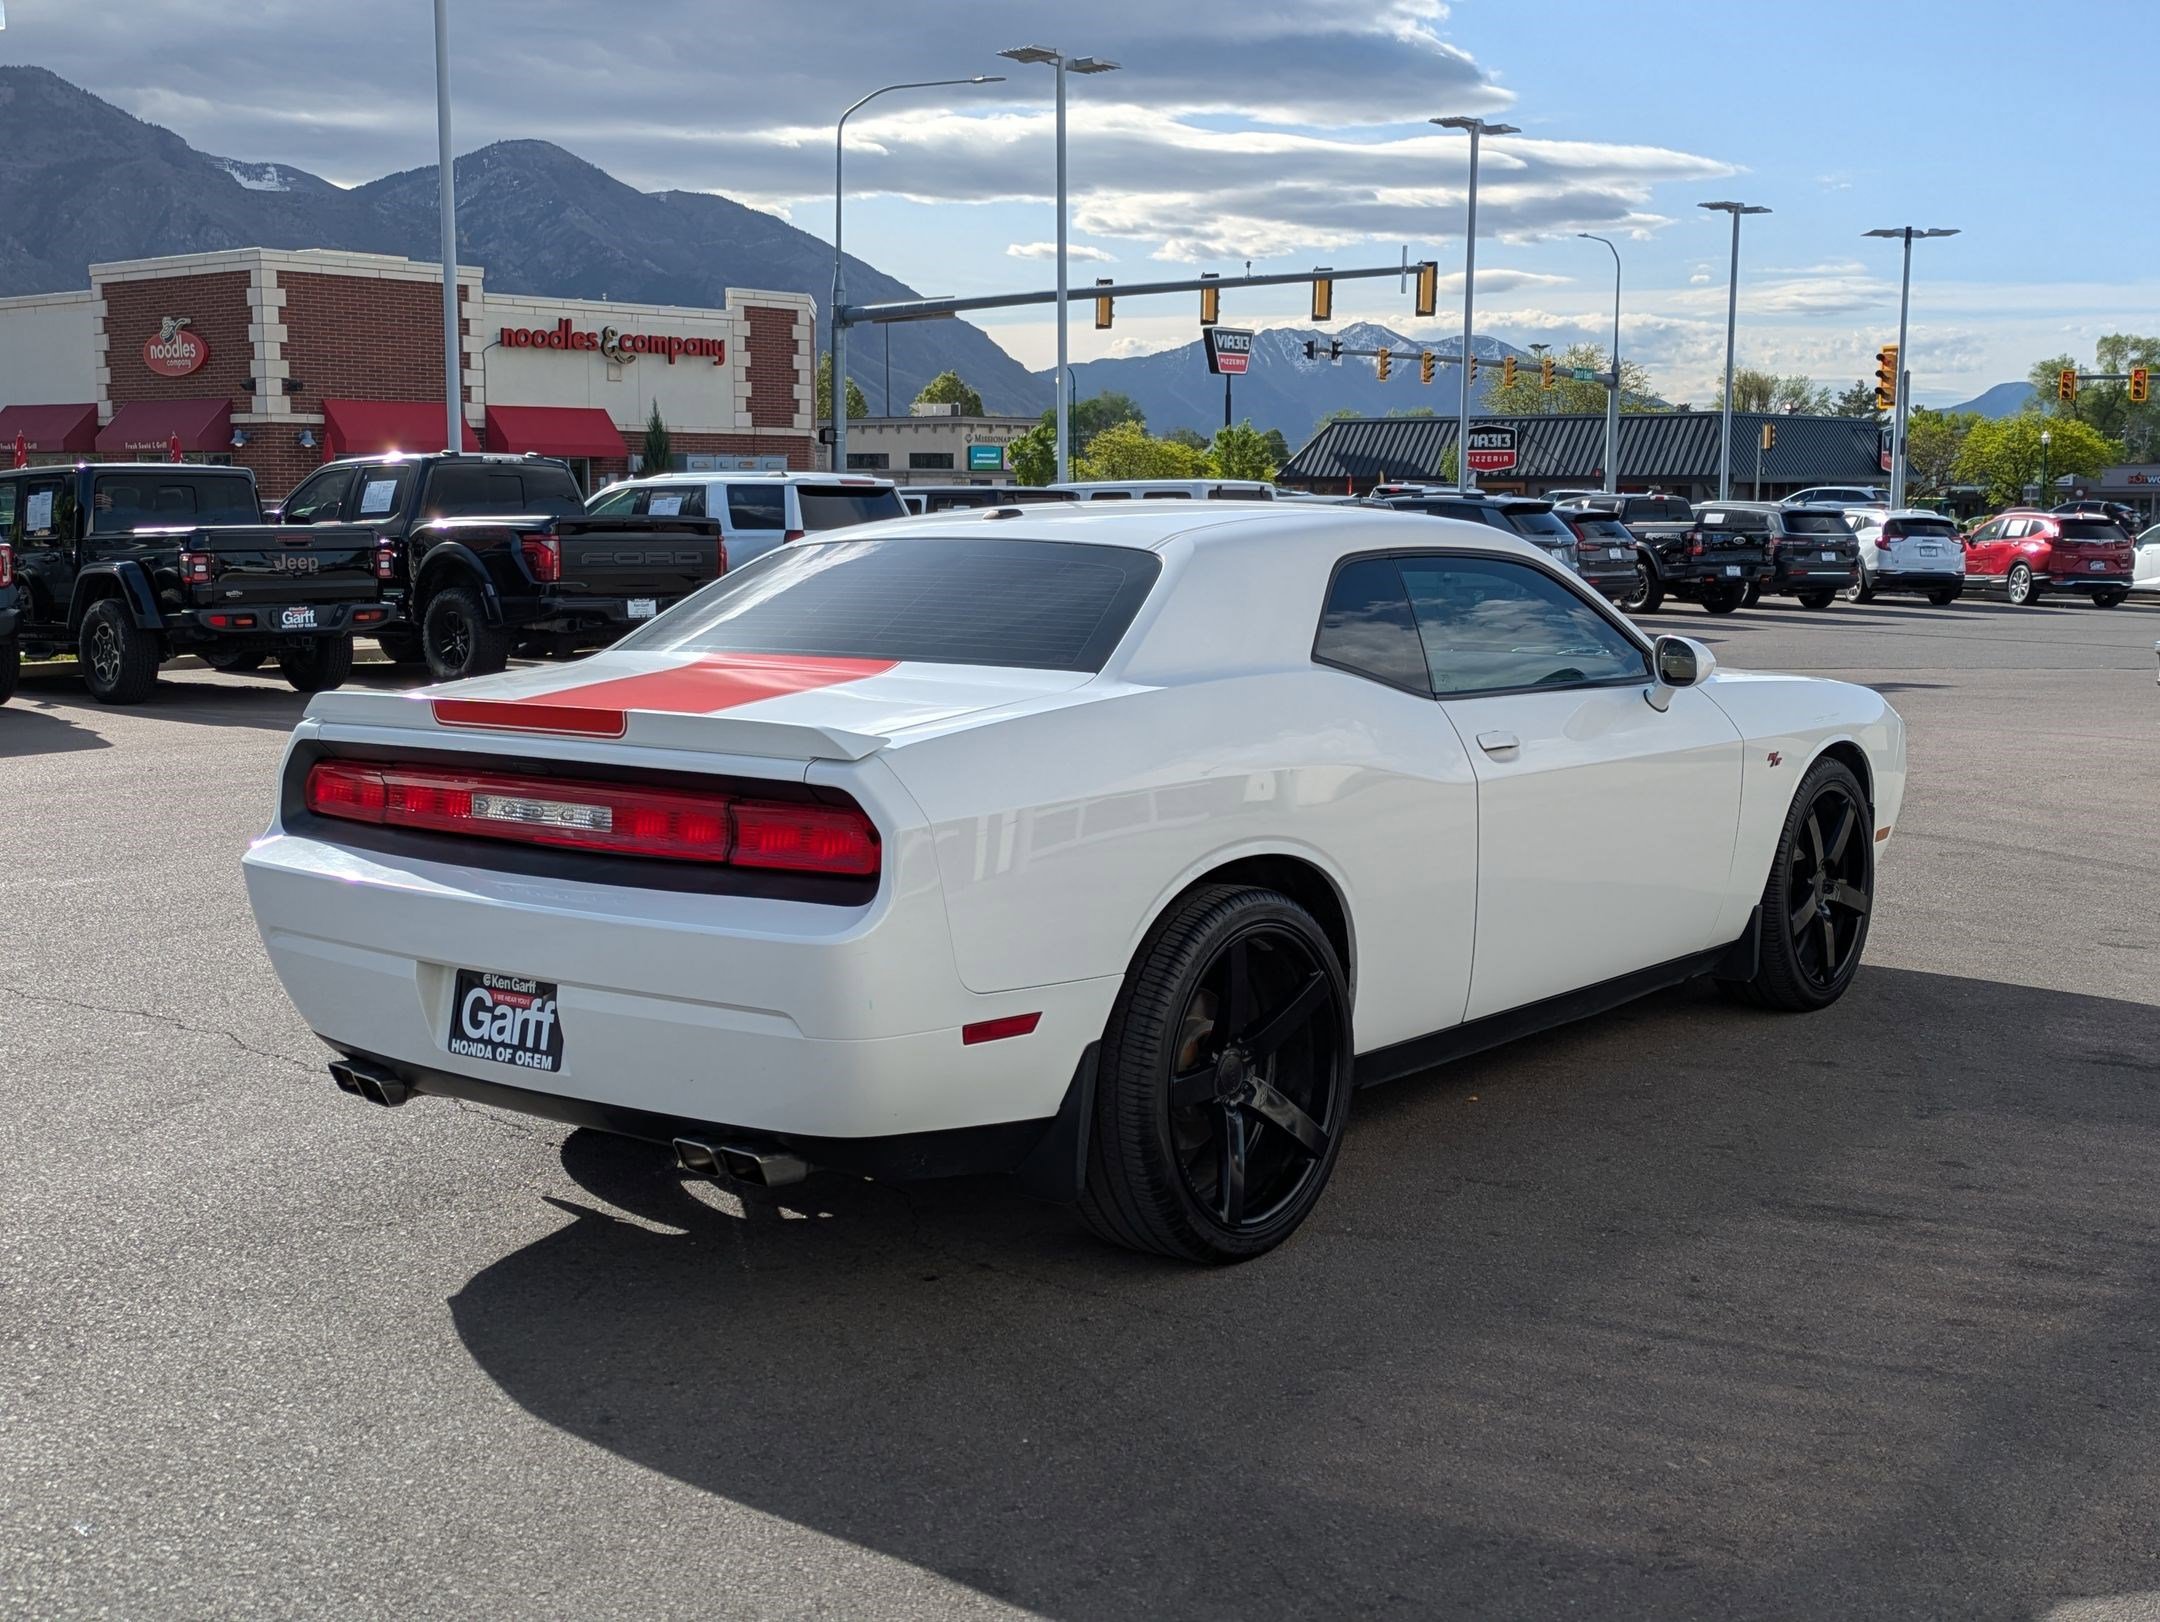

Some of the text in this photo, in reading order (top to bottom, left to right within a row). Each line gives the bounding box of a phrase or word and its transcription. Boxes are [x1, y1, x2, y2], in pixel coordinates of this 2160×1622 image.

[150, 334, 196, 359] noodles
[501, 318, 725, 366] noodles & company
[166, 359, 192, 369] company
[274, 554, 319, 572] Jeep
[581, 552, 703, 565] FORD
[282, 610, 315, 625] Garff
[492, 974, 536, 993] Ken Garff
[462, 987, 556, 1051] Garff
[451, 1038, 553, 1070] HONDA OF OREM
